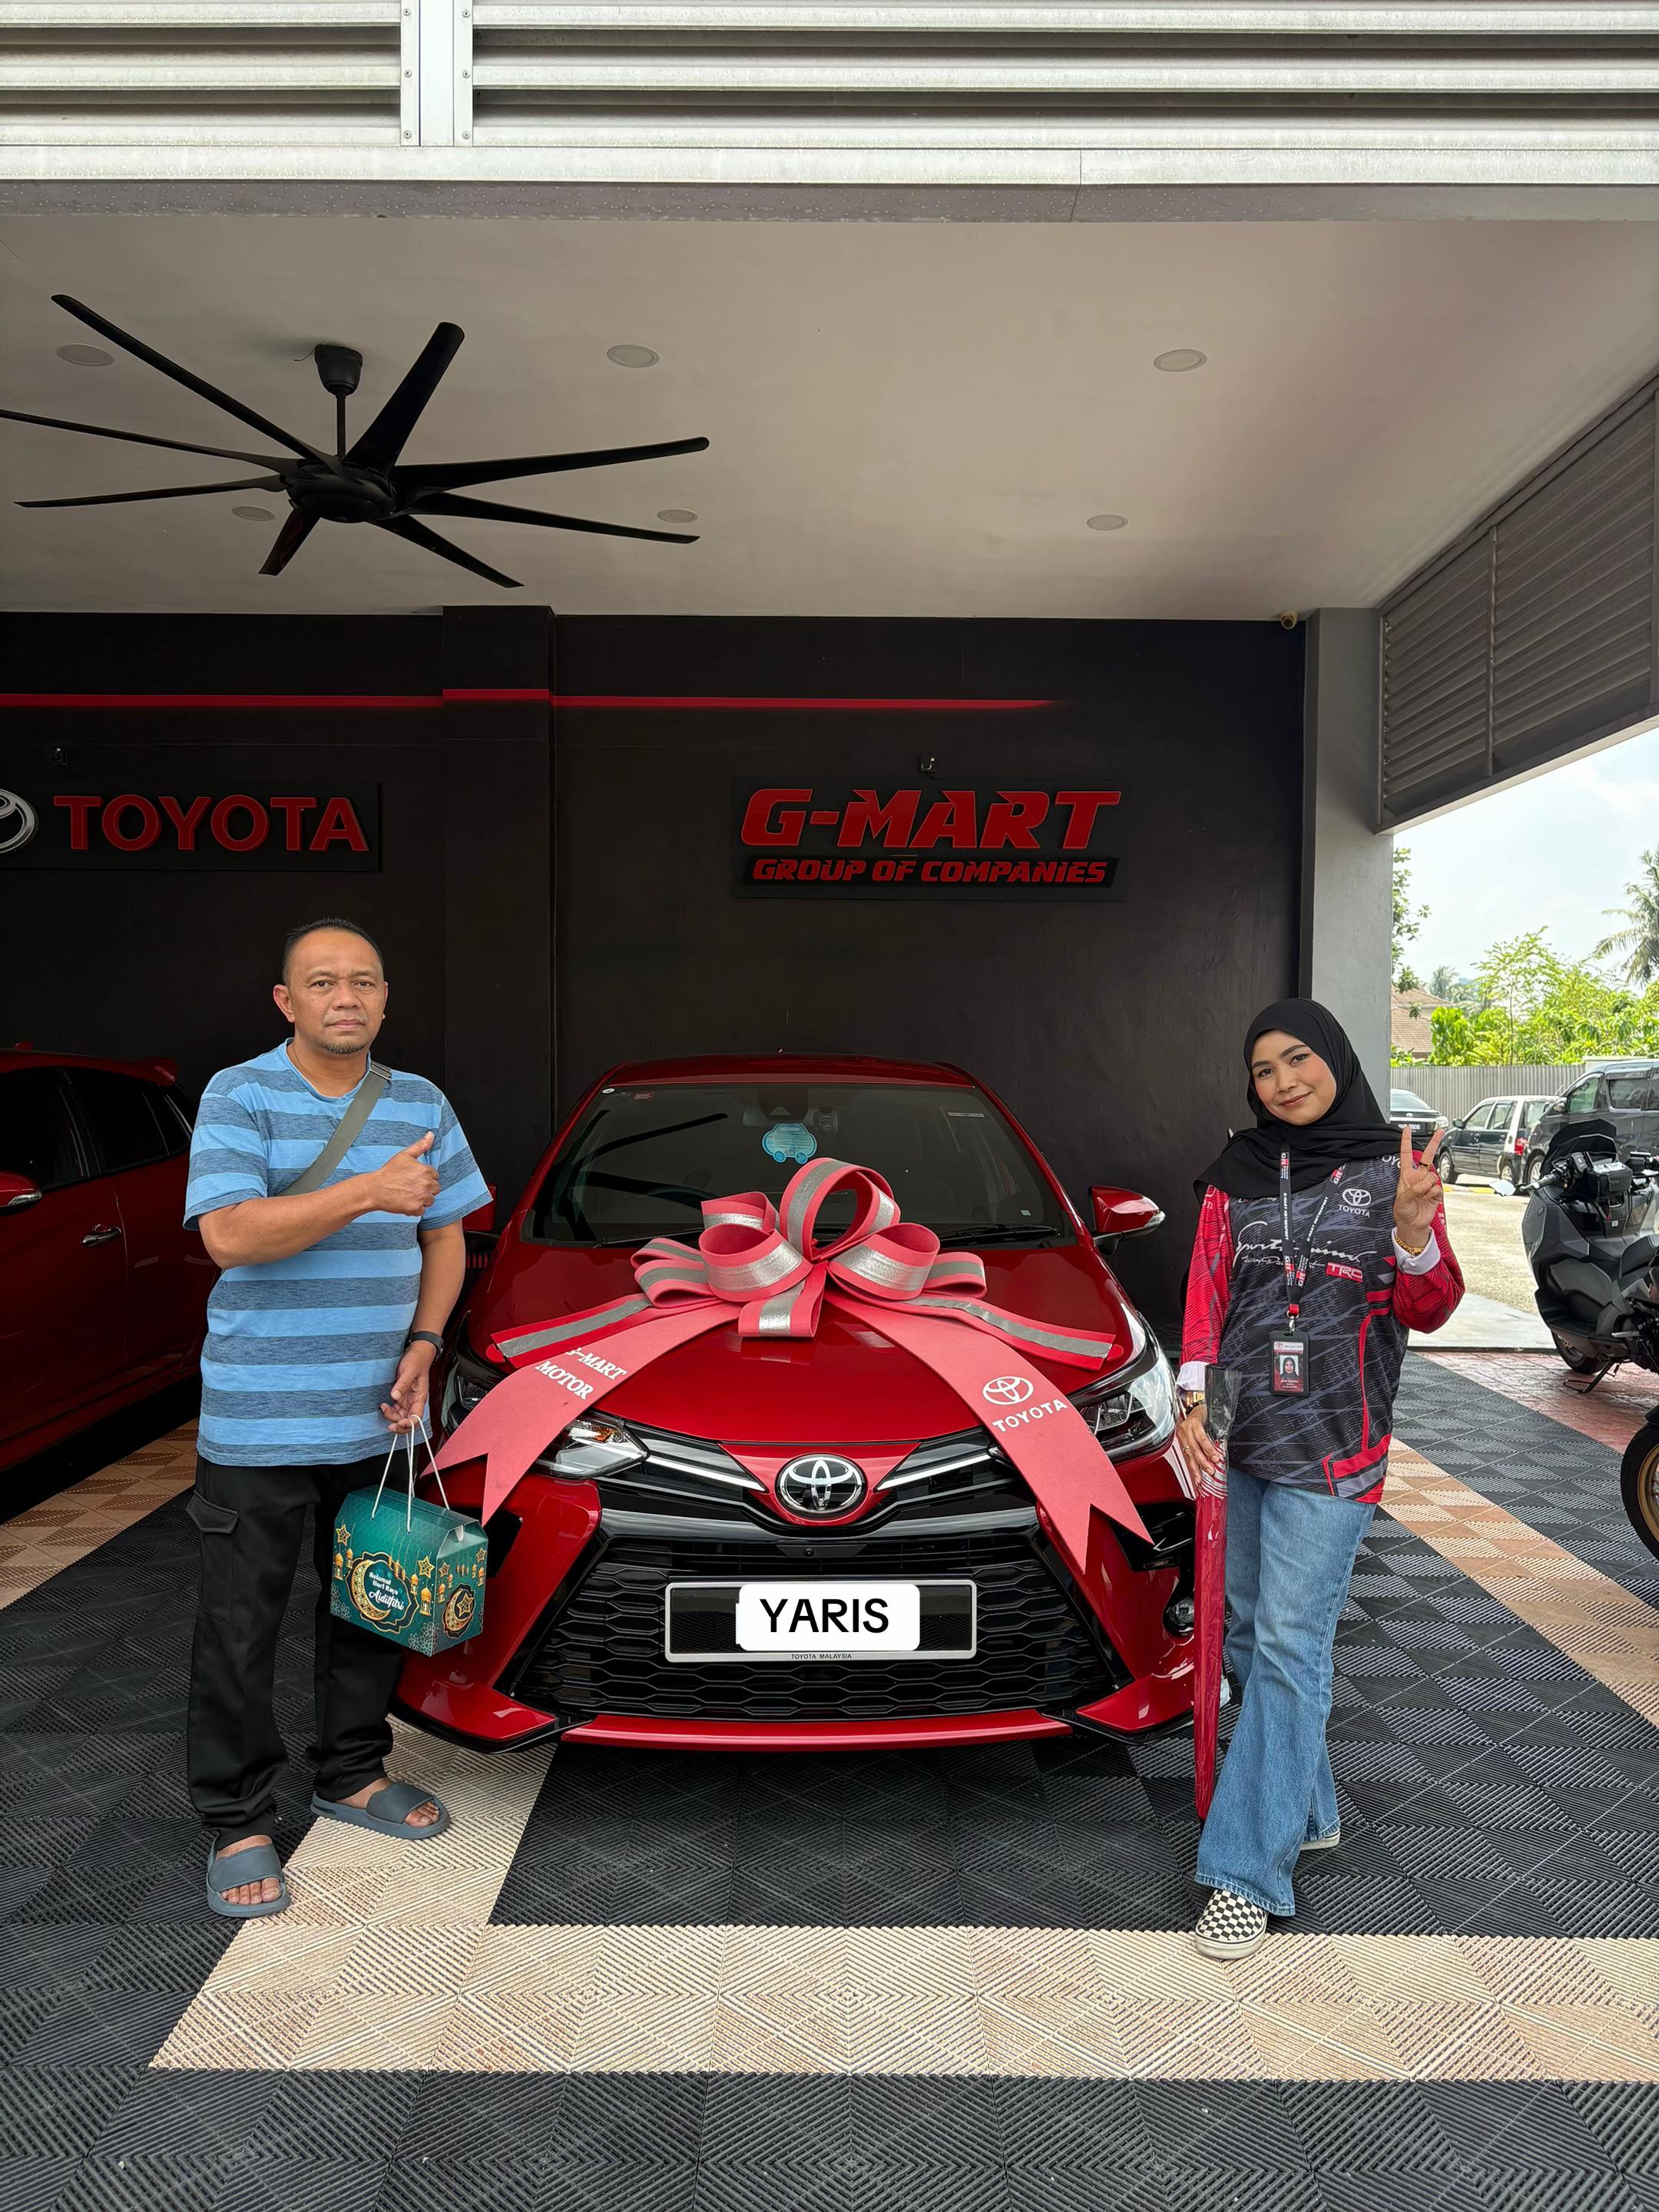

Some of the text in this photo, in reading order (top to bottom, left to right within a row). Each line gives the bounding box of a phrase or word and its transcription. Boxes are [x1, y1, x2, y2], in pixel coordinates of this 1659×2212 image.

[54, 794, 369, 852] TOYOTA
[741, 788, 1122, 849] G-MART
[753, 859, 1108, 882] GROUP OF COMPANIES
[1338, 1204, 1371, 1218] TOYOTA
[1328, 1263, 1363, 1280] TRD
[535, 1360, 594, 1400] MOTOR
[992, 1399, 1068, 1432] TOYOTA
[369, 1589, 405, 1610] Aidilfitri
